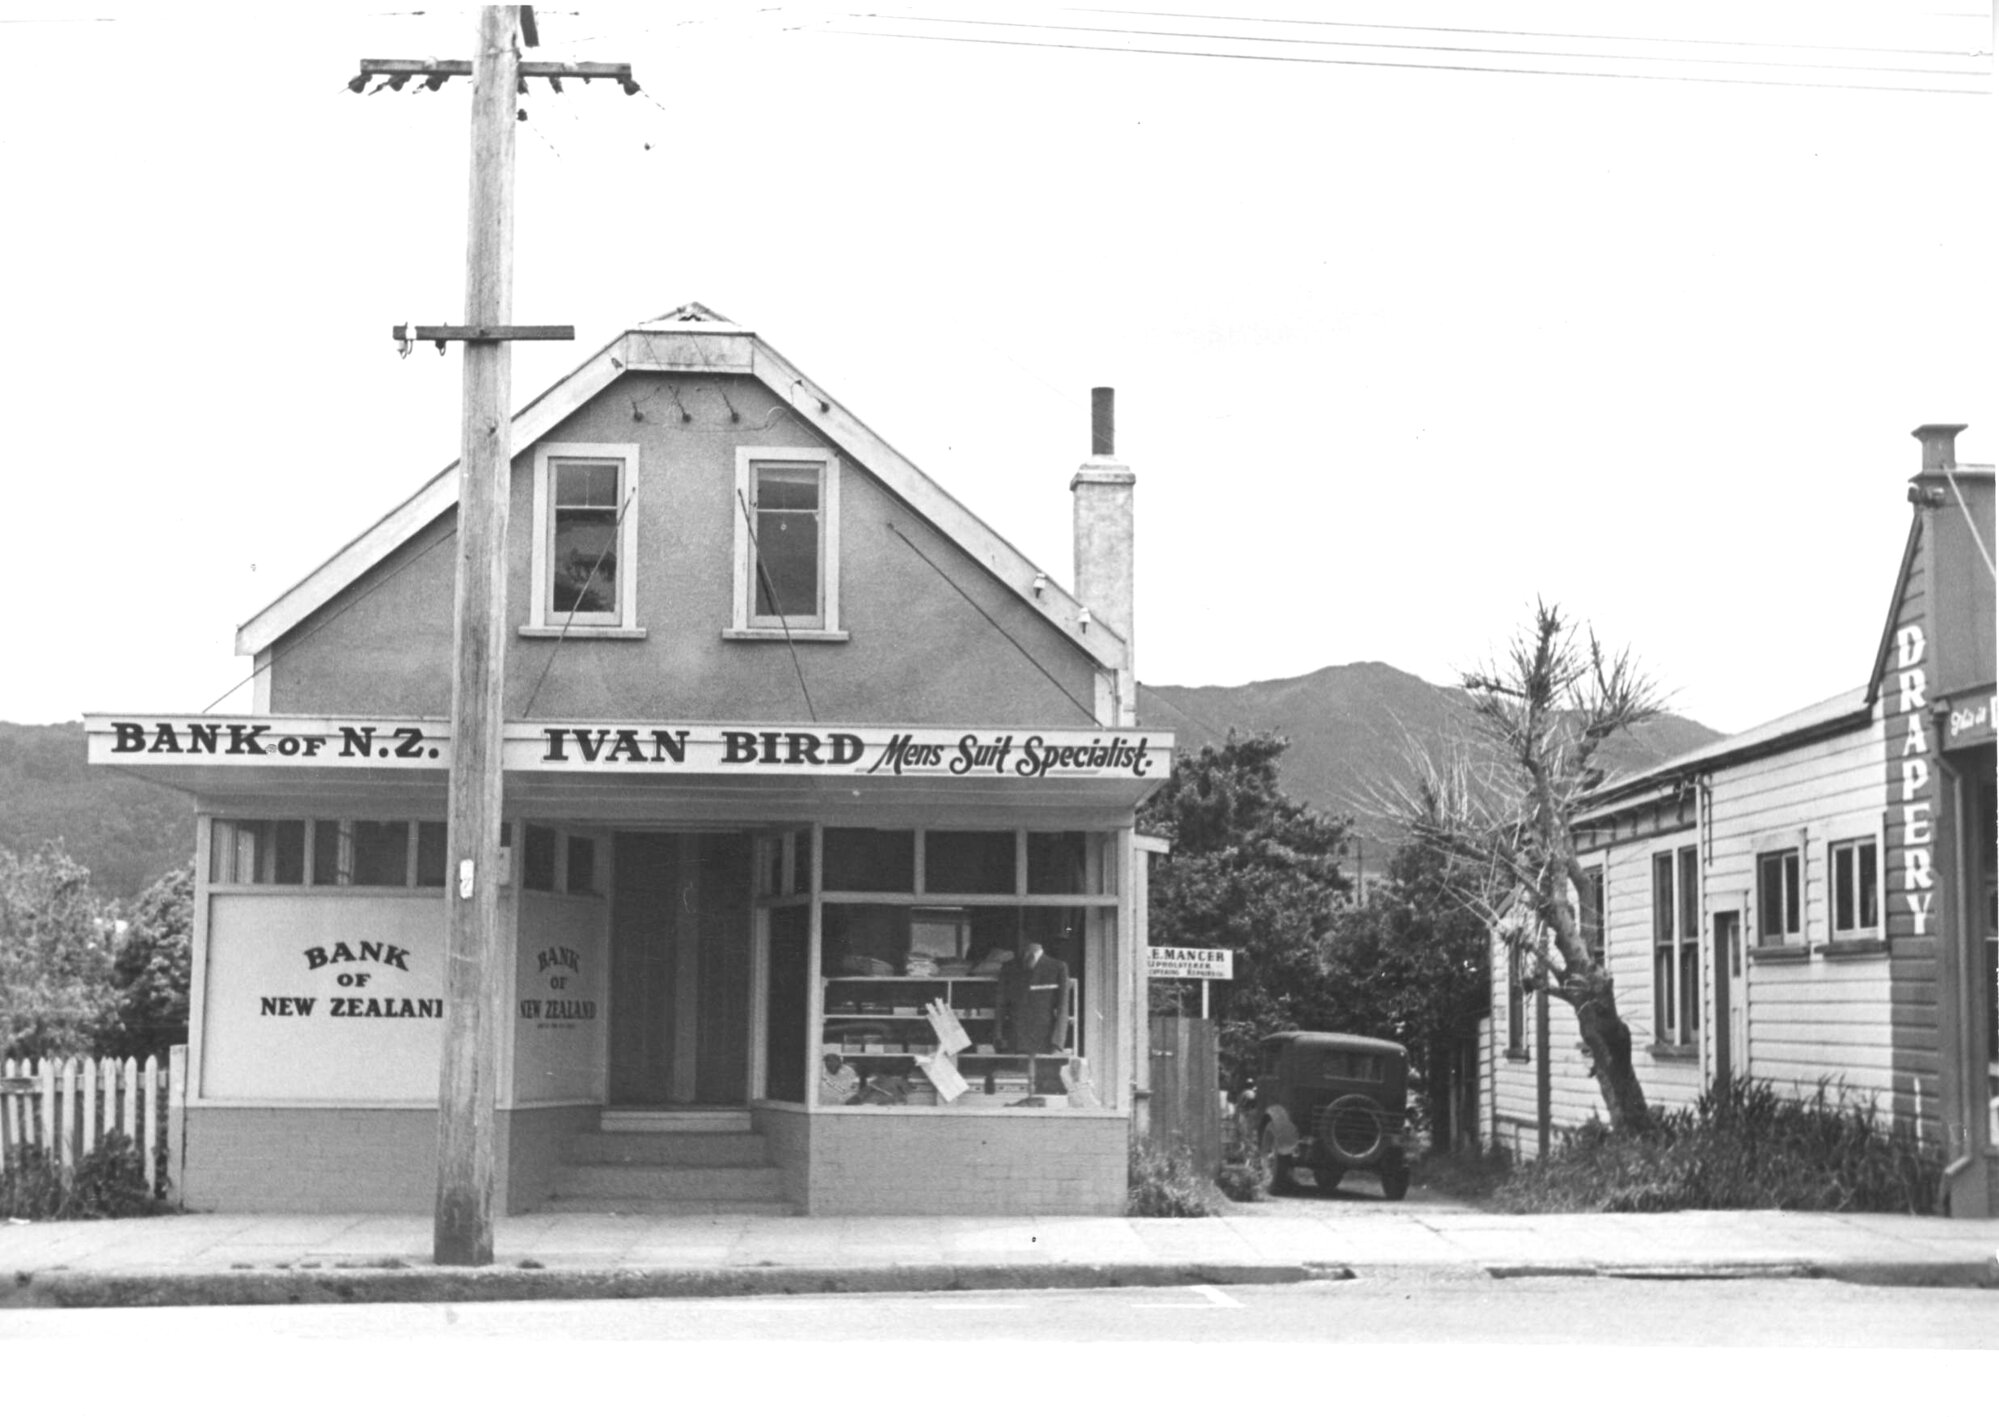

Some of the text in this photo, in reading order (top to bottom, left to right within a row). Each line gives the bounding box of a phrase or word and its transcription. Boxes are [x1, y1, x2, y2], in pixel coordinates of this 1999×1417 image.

[110, 722, 439, 759] BANK OF N.Z.
[543, 728, 1152, 777] IVAN BIRD Mens Suit Specialist.
[1897, 624, 1936, 935] DRAPERY
[304, 940, 410, 972] BANK
[538, 946, 580, 973] BANK
[337, 973, 371, 987] OF
[550, 976, 567, 990] OF
[260, 997, 316, 1016] NEW
[520, 999, 597, 1020] NEW ZEALAND
